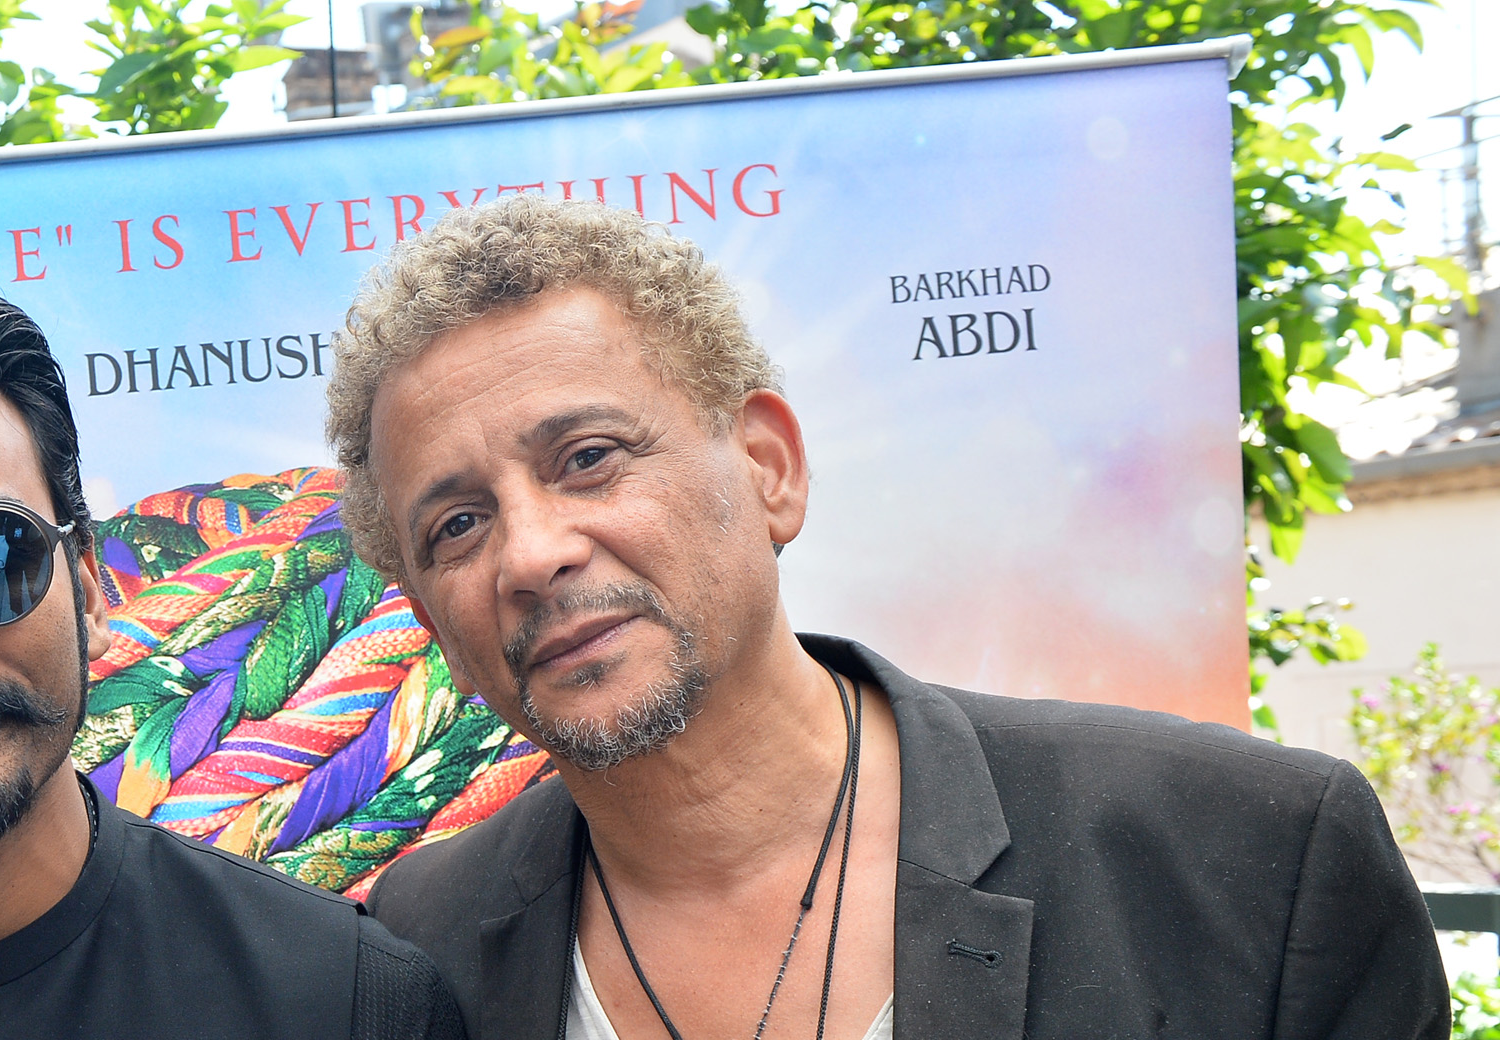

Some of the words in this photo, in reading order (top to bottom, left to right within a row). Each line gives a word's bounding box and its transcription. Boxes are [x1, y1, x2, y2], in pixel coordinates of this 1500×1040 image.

[112, 214, 185, 273] IS
[222, 162, 786, 262] EVERING
[889, 264, 1051, 304] BARKHAD
[912, 307, 1038, 361] ABDI
